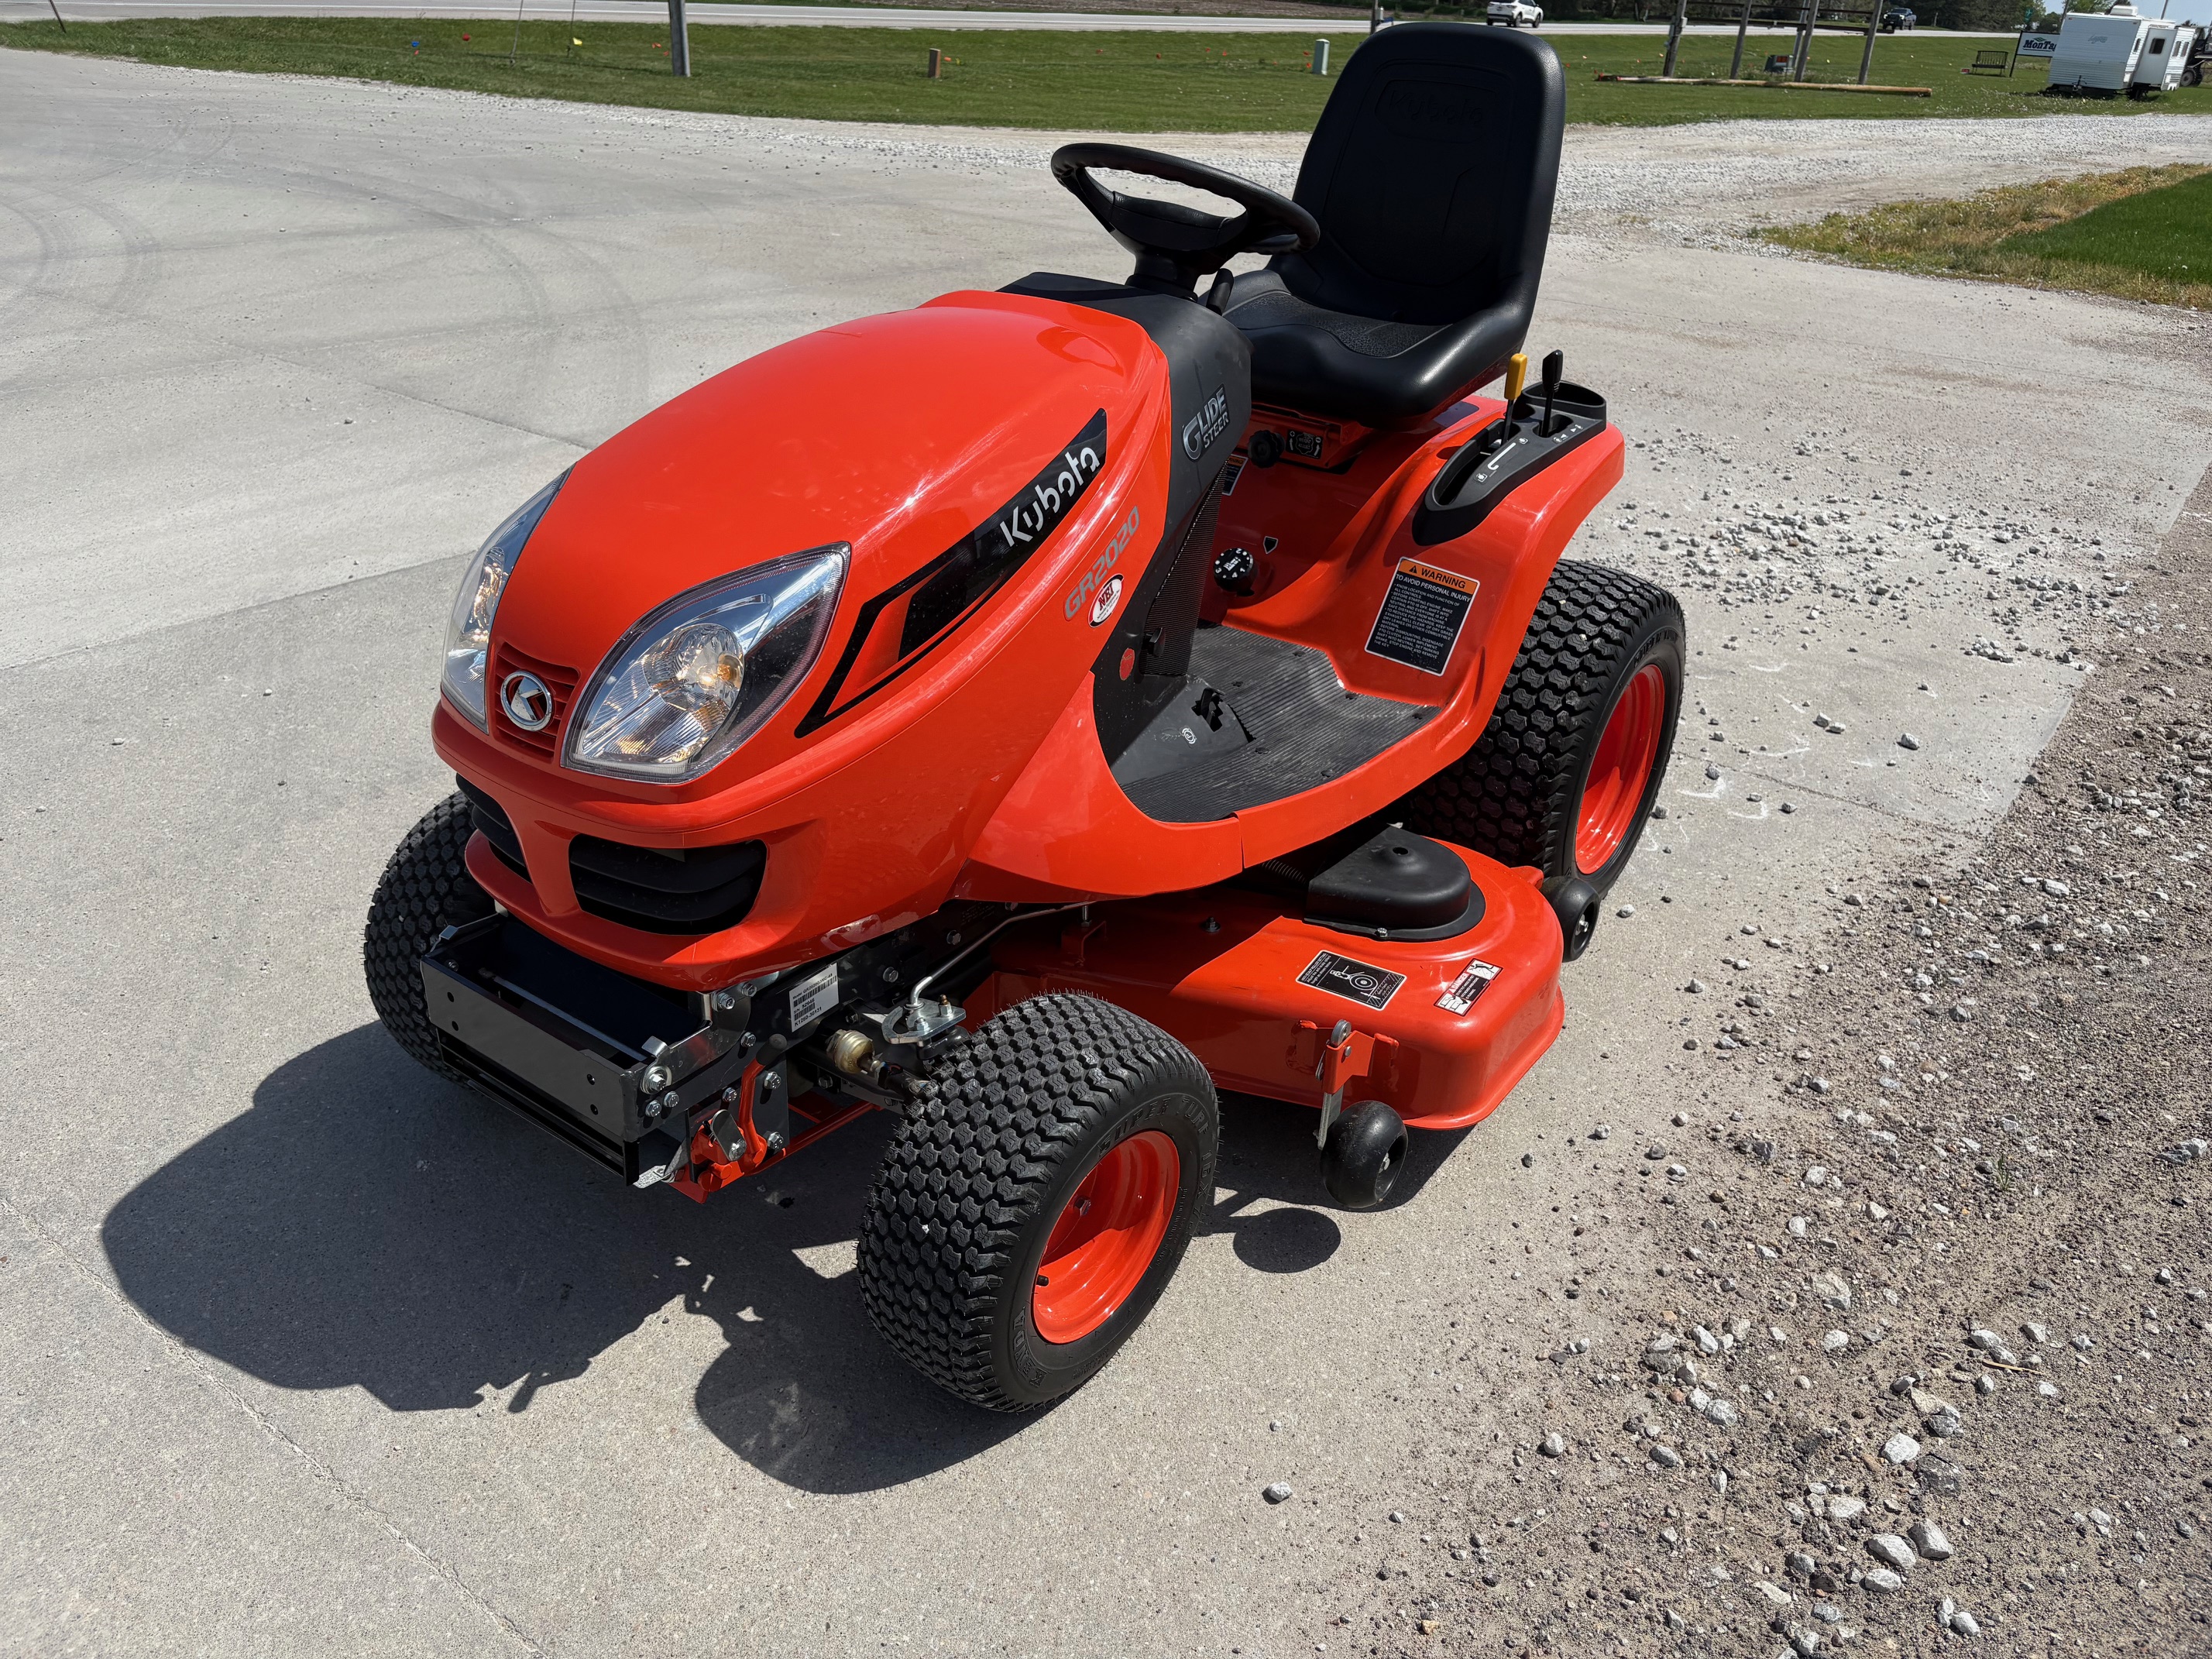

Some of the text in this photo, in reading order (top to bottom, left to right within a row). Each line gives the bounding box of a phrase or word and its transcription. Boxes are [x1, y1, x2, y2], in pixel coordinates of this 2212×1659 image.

[1183, 386, 1226, 461] GLIDE
[1204, 411, 1230, 448] STEER
[999, 447, 1101, 548] Kubota
[1065, 506, 1140, 620] GR2020
[1403, 576, 1420, 586] AVOID
[1420, 582, 1451, 596] PERSONAL
[1450, 591, 1471, 603] INJURY
[1420, 568, 1466, 589] WARNING
[1098, 582, 1114, 611] NEI
[1012, 1306, 1048, 1388] KENDA
